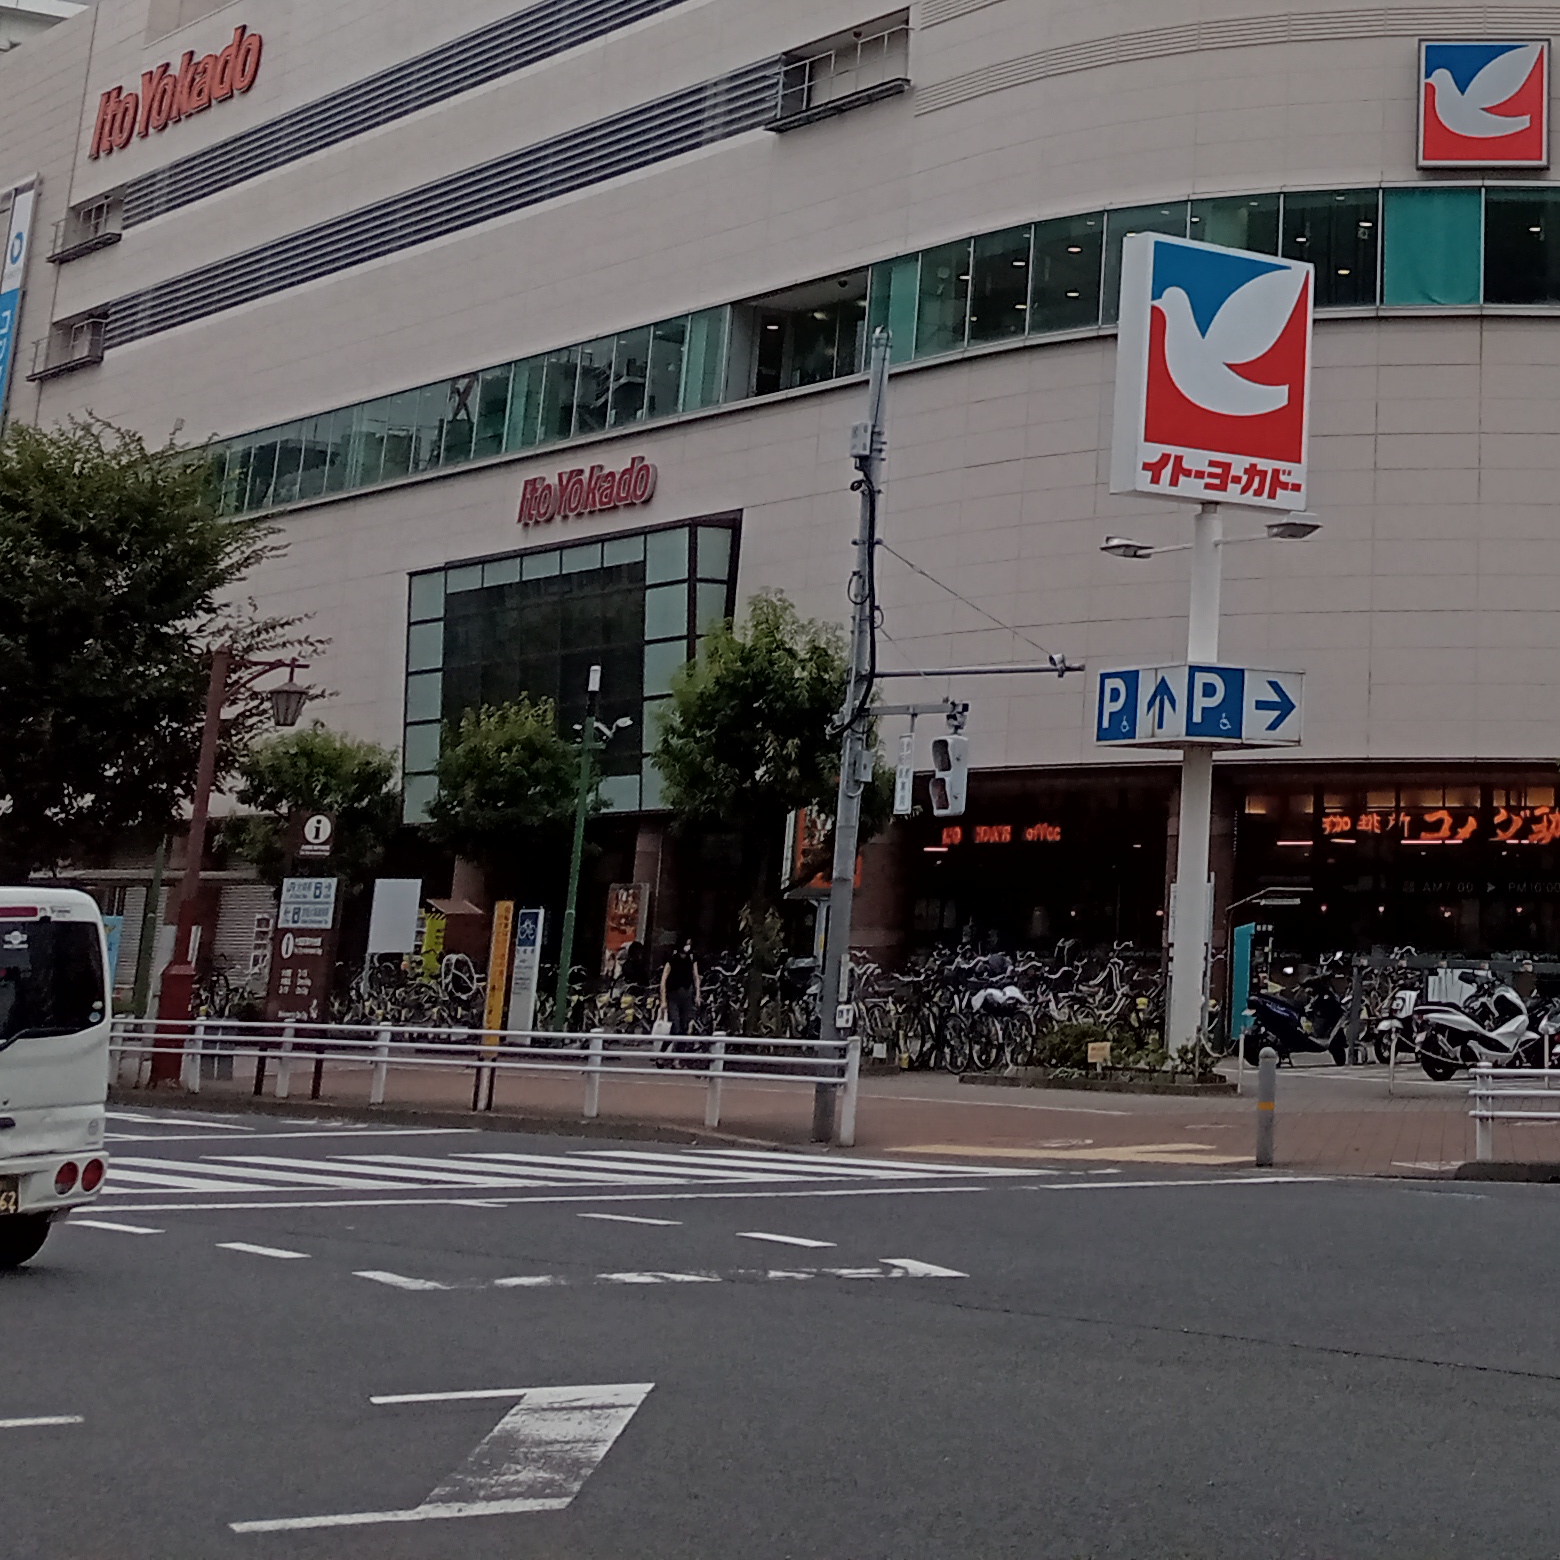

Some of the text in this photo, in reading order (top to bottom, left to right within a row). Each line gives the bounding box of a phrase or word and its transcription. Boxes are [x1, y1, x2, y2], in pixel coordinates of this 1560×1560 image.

[88, 24, 263, 160] Ito Yokado
[517, 455, 657, 526] Ito Yokado
[1142, 452, 1302, 501] イトーヨーカドー
[1102, 677, 1127, 730] P
[1192, 670, 1226, 724] P
